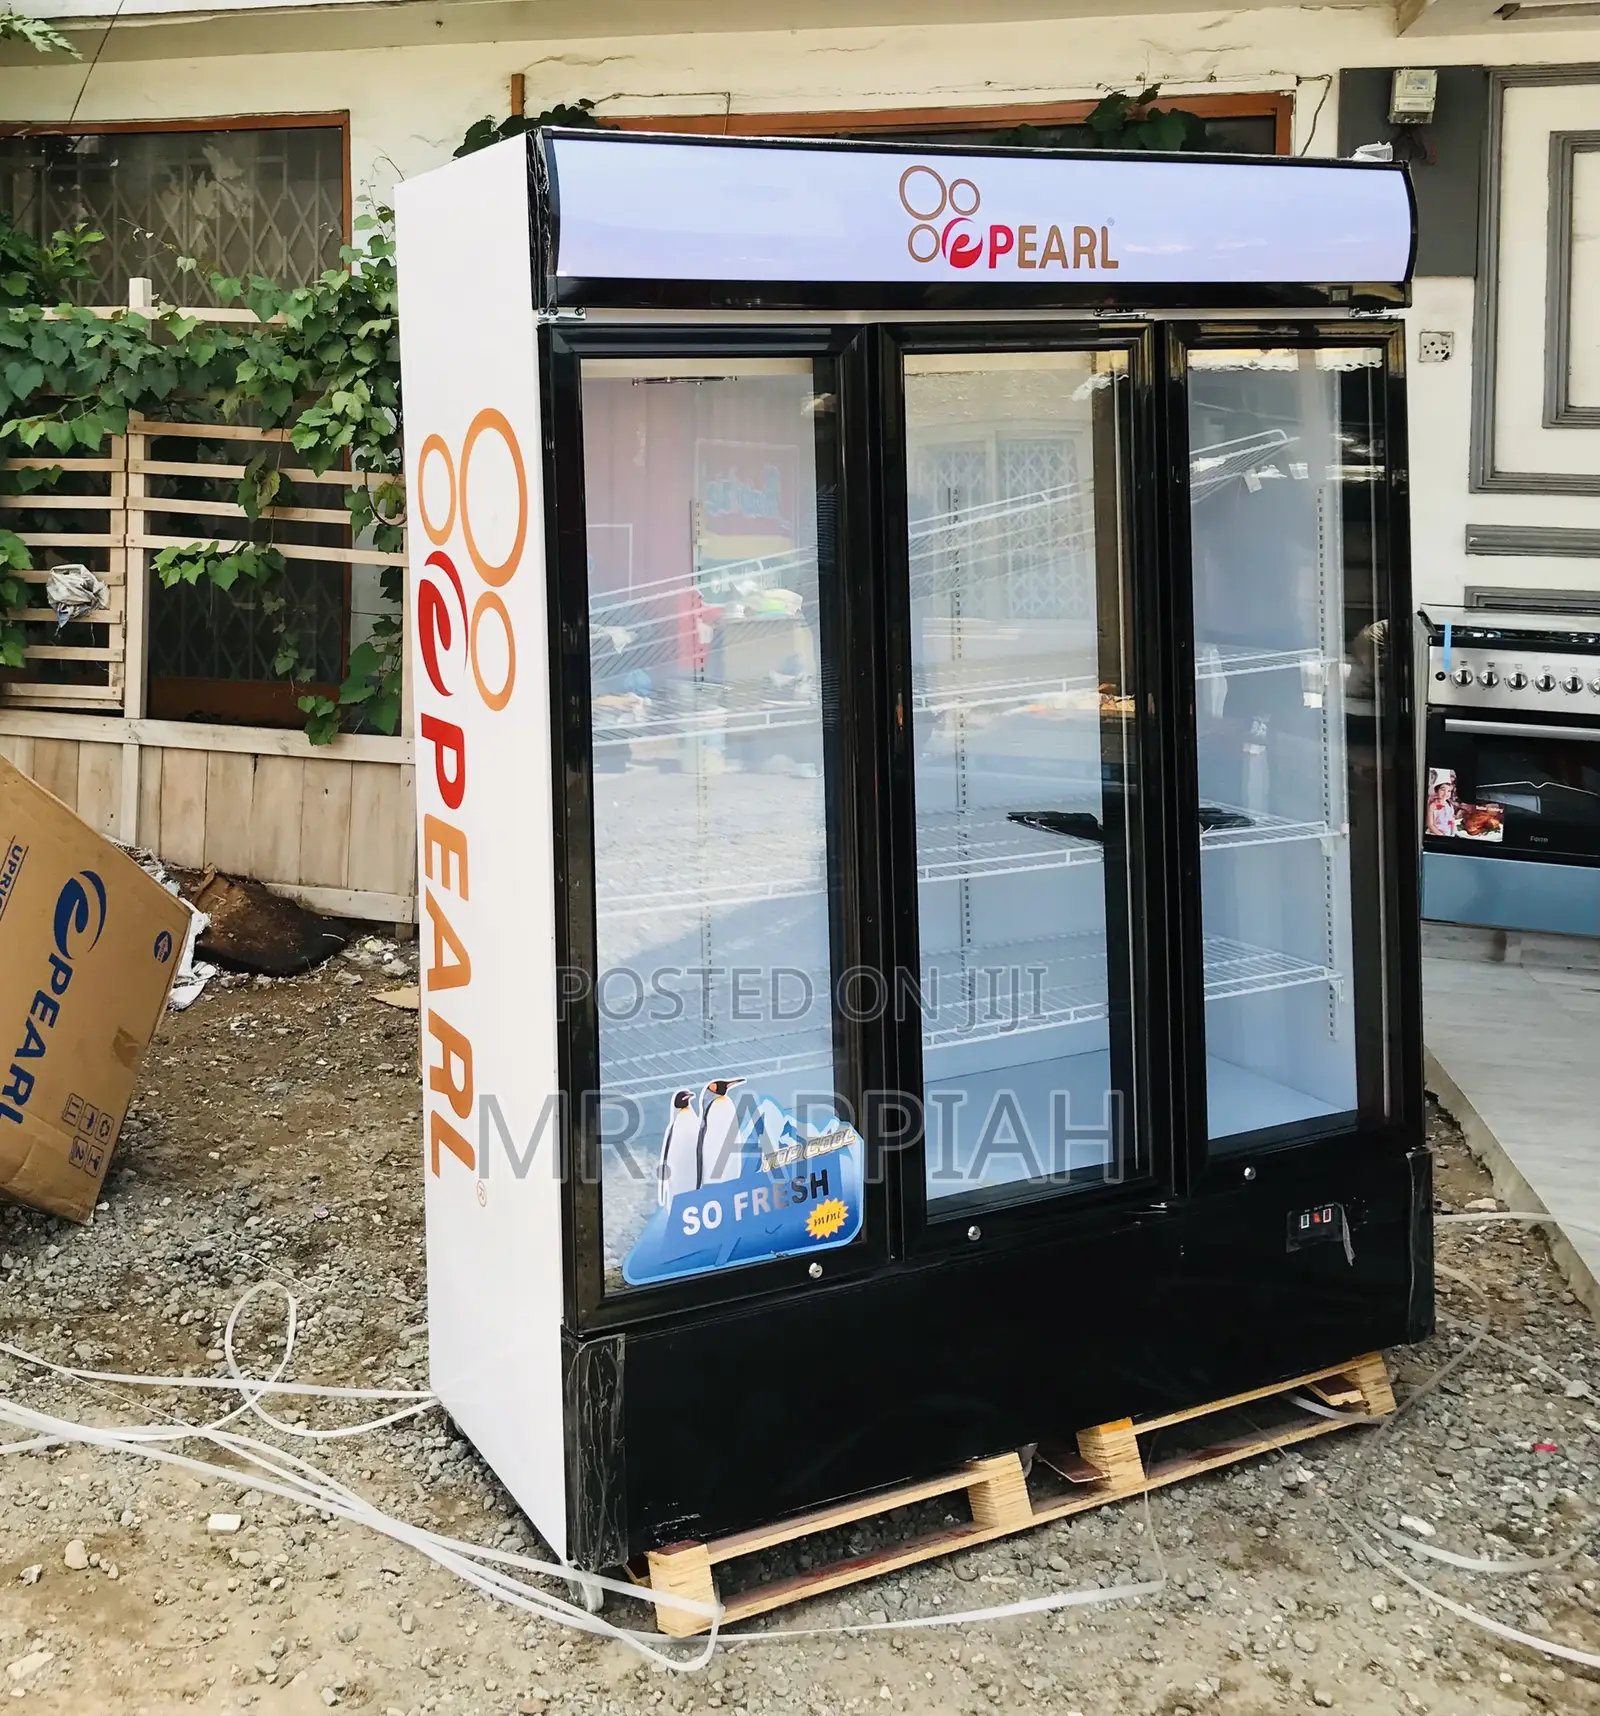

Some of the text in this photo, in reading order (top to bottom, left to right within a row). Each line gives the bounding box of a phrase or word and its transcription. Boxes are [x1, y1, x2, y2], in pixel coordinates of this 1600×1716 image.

[988, 224, 1119, 269] PEARL
[0, 845, 23, 908] UPRI
[421, 713, 476, 1178] PEARL
[0, 952, 73, 1124] PEARL
[760, 1128, 857, 1172] TOP COOL
[682, 1168, 829, 1236] SO FRESH
[813, 1206, 843, 1228] mini
